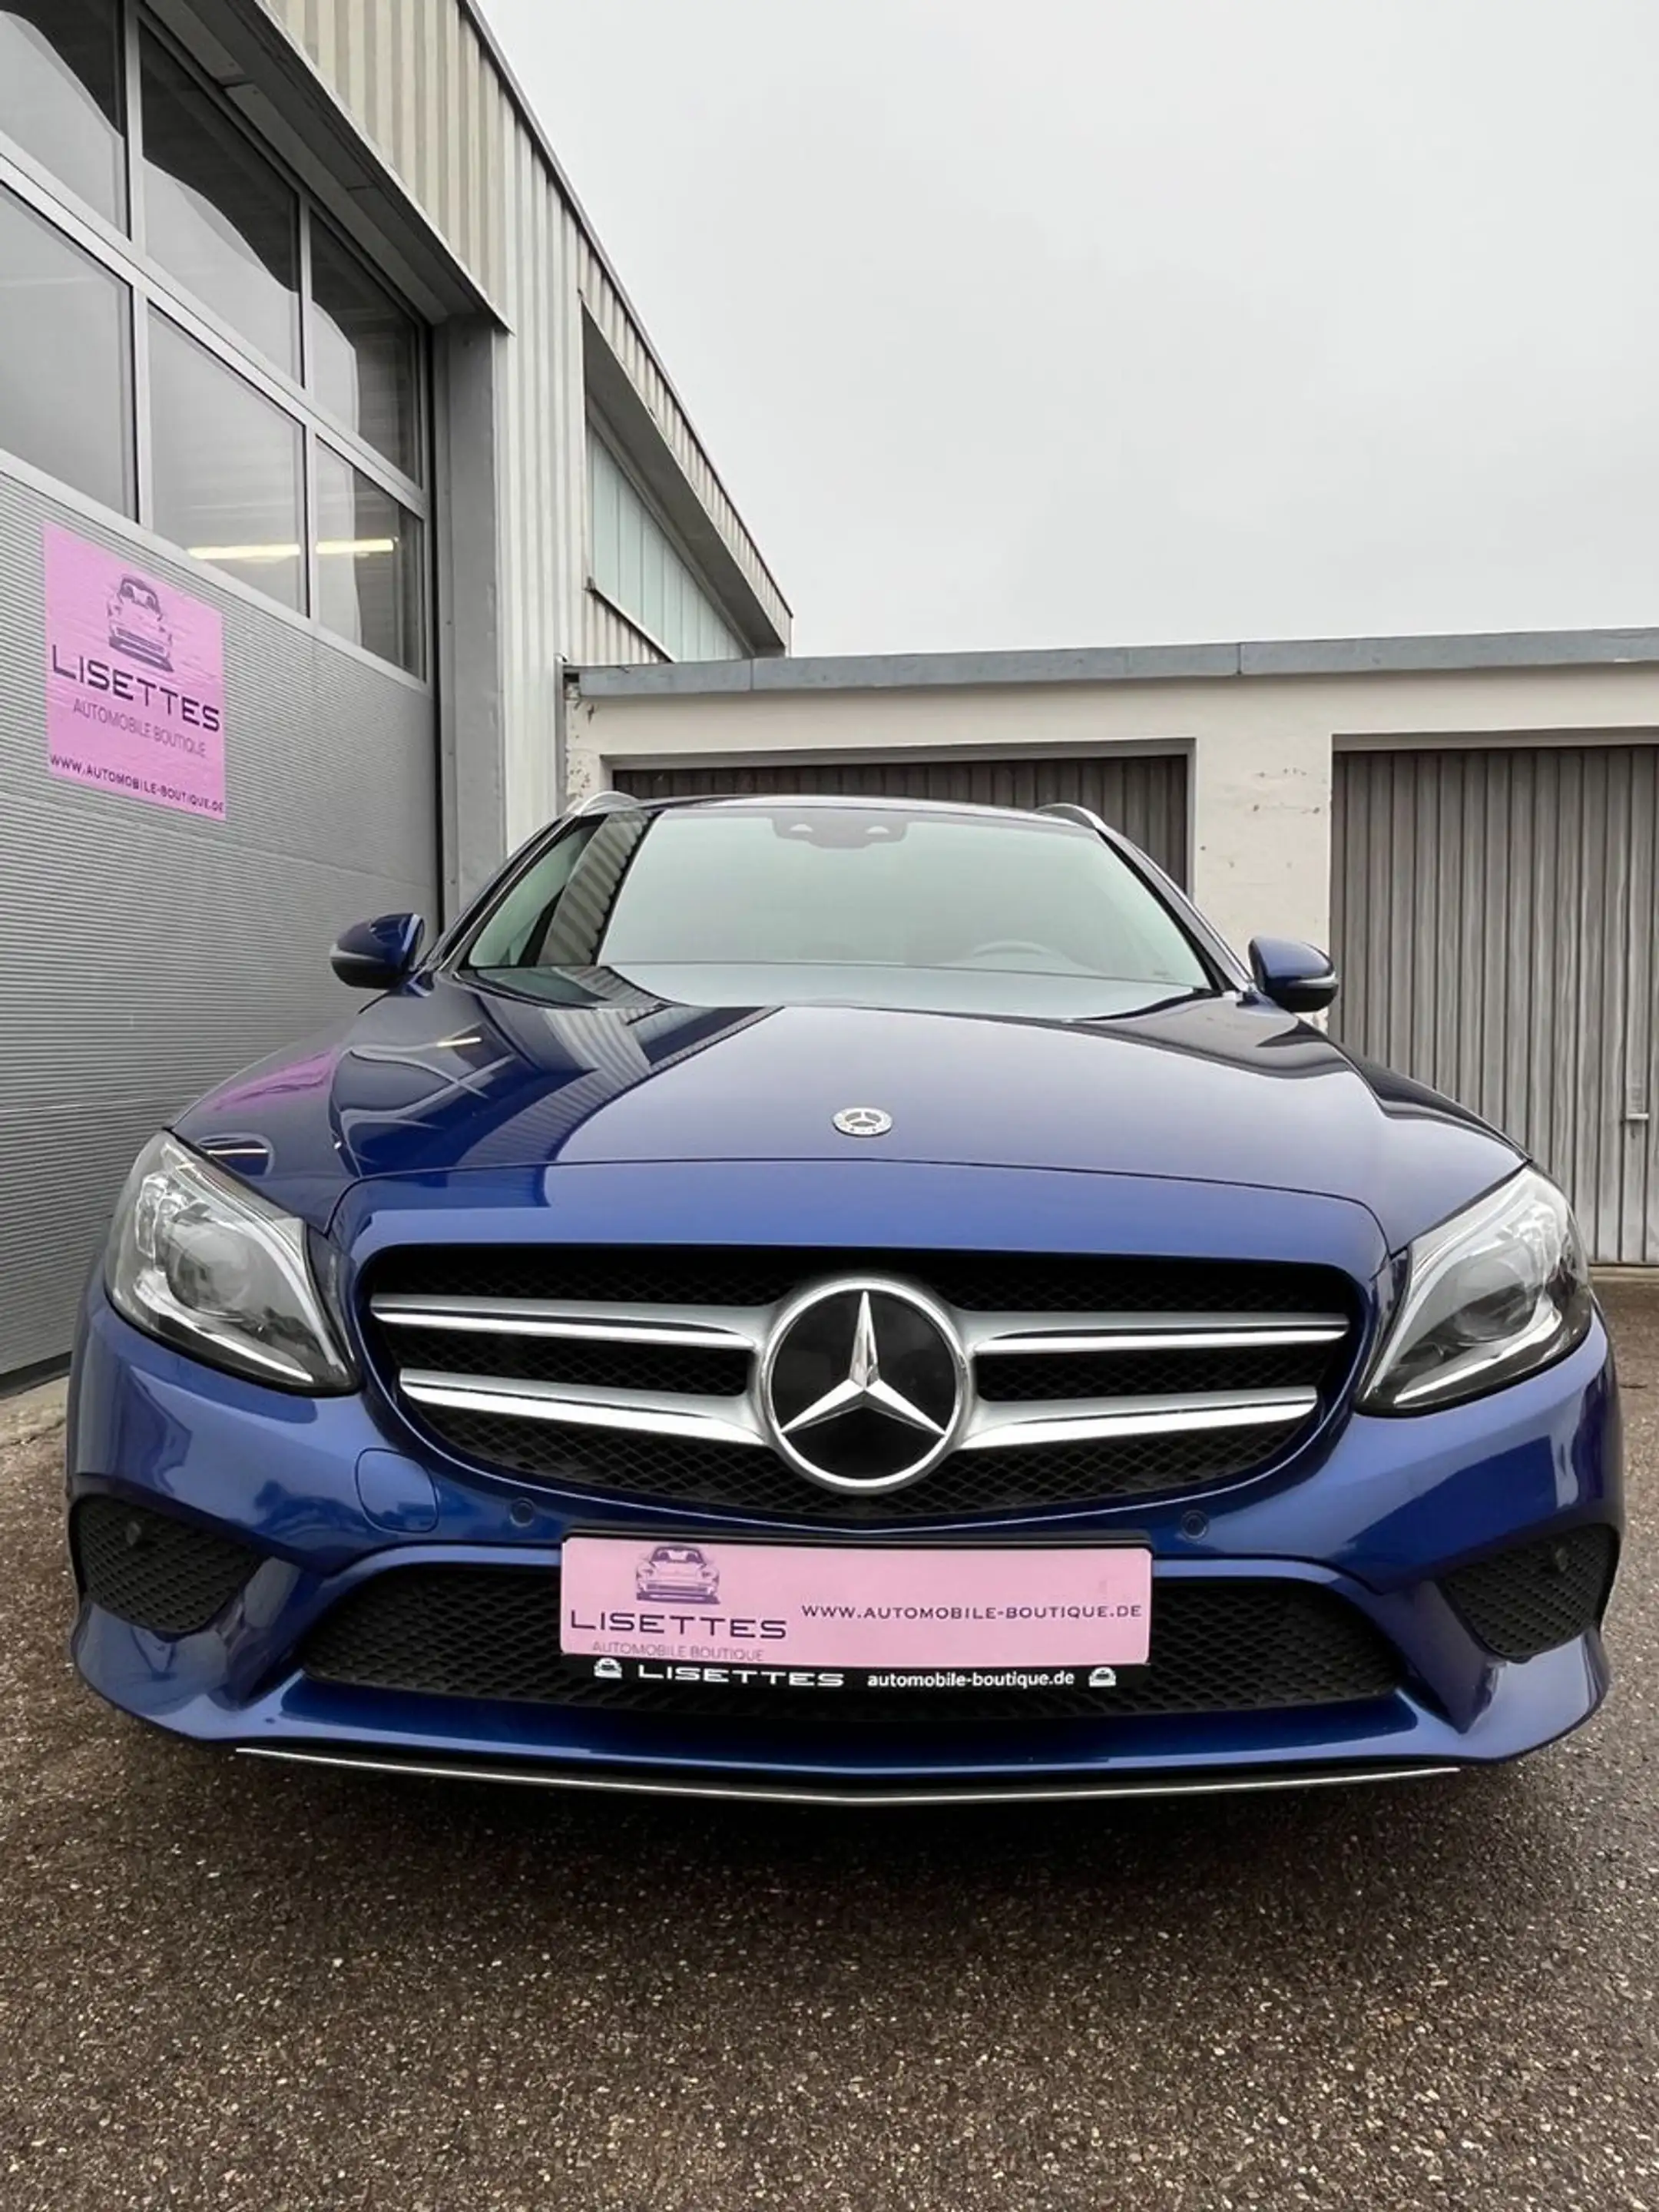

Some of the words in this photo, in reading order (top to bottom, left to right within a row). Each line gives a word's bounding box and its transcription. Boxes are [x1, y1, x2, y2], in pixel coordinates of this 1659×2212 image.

[51, 644, 221, 733] LISETTES
[73, 697, 152, 739] AUTOMOBILE
[154, 723, 207, 759] BOUTIQUE
[50, 754, 224, 812] WWW.AUTOMOBILE-BOUTIQUE.DE
[570, 1610, 787, 1640] LISETTES
[801, 1604, 1143, 1620] WWW.AUTOMOBILE-BOUTIQUE.DE
[591, 1640, 686, 1659] AUTOMOBILE
[690, 1645, 764, 1663] BOUTIQUE
[637, 1664, 845, 1688] LISETTES
[866, 1669, 1075, 1690] automobile-boutique.de
